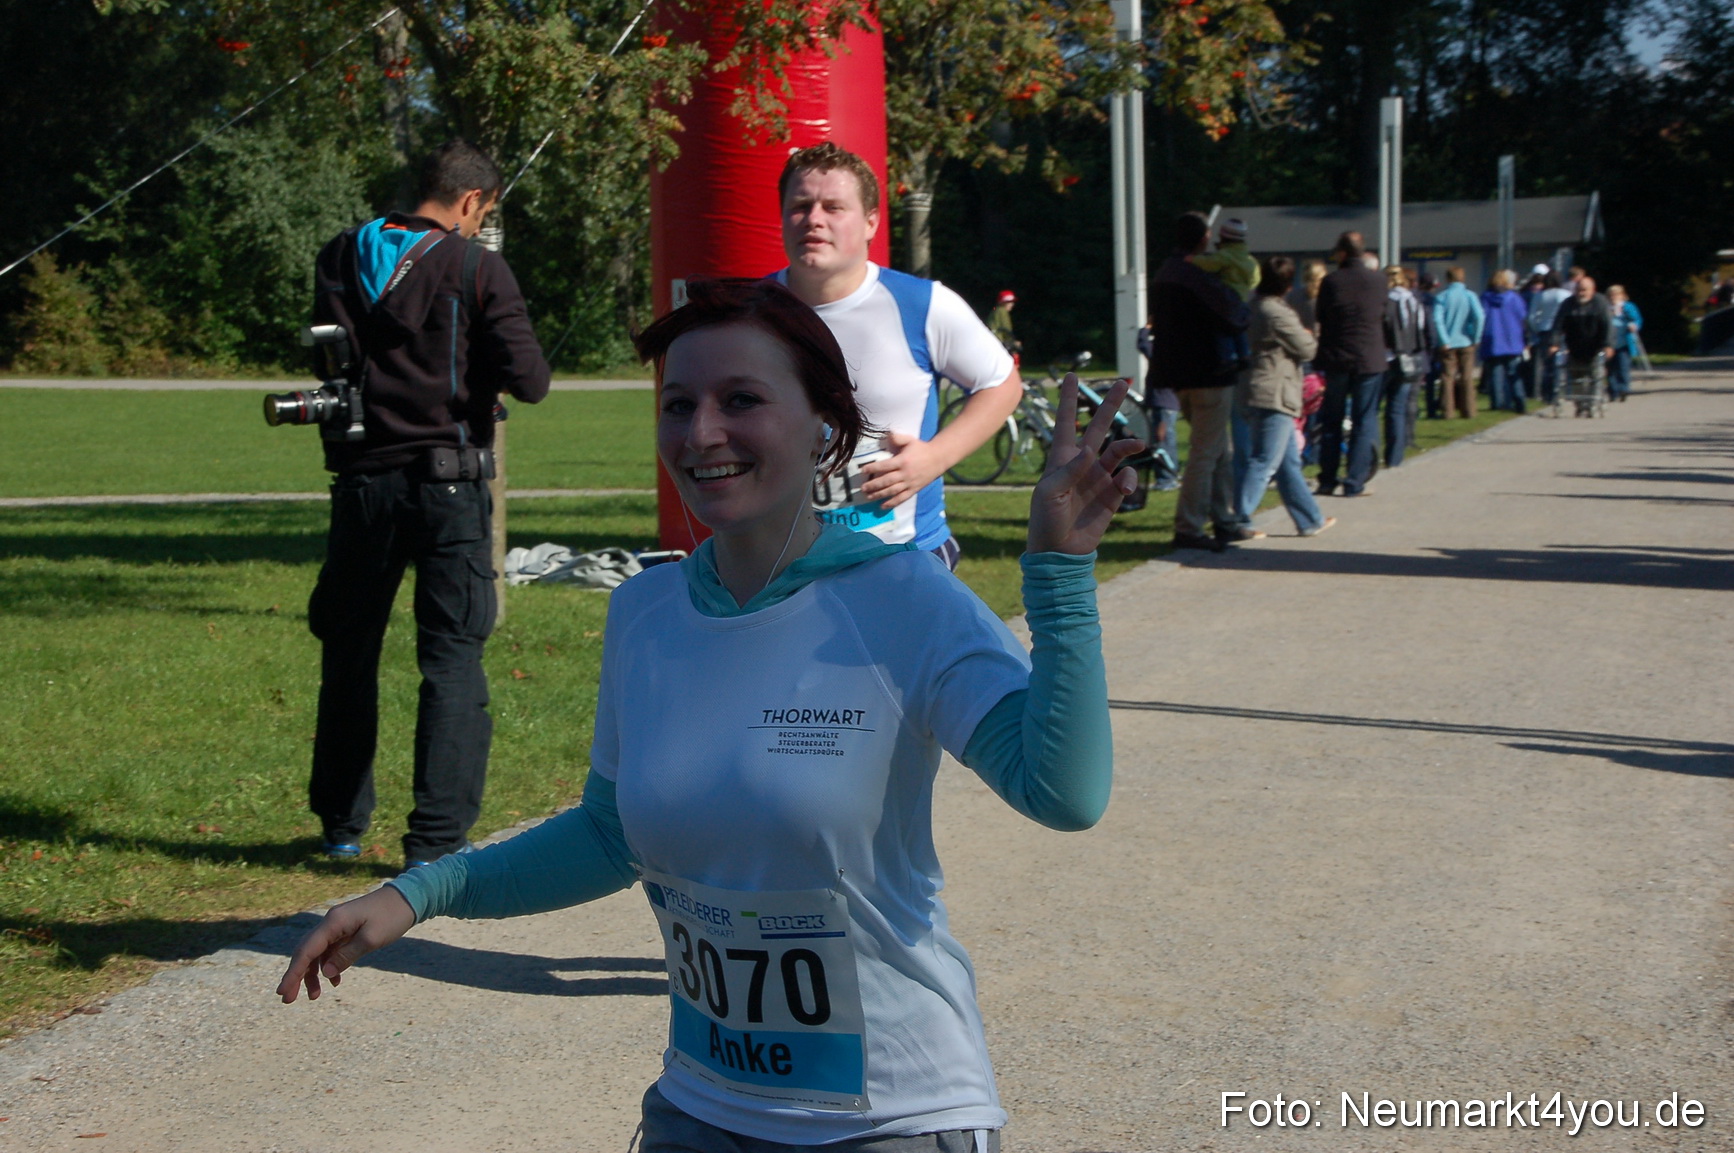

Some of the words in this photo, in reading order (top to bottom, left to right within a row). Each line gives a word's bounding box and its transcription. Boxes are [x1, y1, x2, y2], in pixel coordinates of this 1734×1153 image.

[762, 708, 866, 725] THORWART
[777, 731, 840, 740] RECHTSANWÄLTE
[777, 739, 836, 748] STEUERBERATER
[767, 747, 845, 757] WIRTSCHAFTSPRÜFER
[662, 885, 733, 927] PFLEIDERER
[759, 914, 826, 931] BOCK
[672, 921, 831, 1026] 3070
[709, 1021, 793, 1076] Anke
